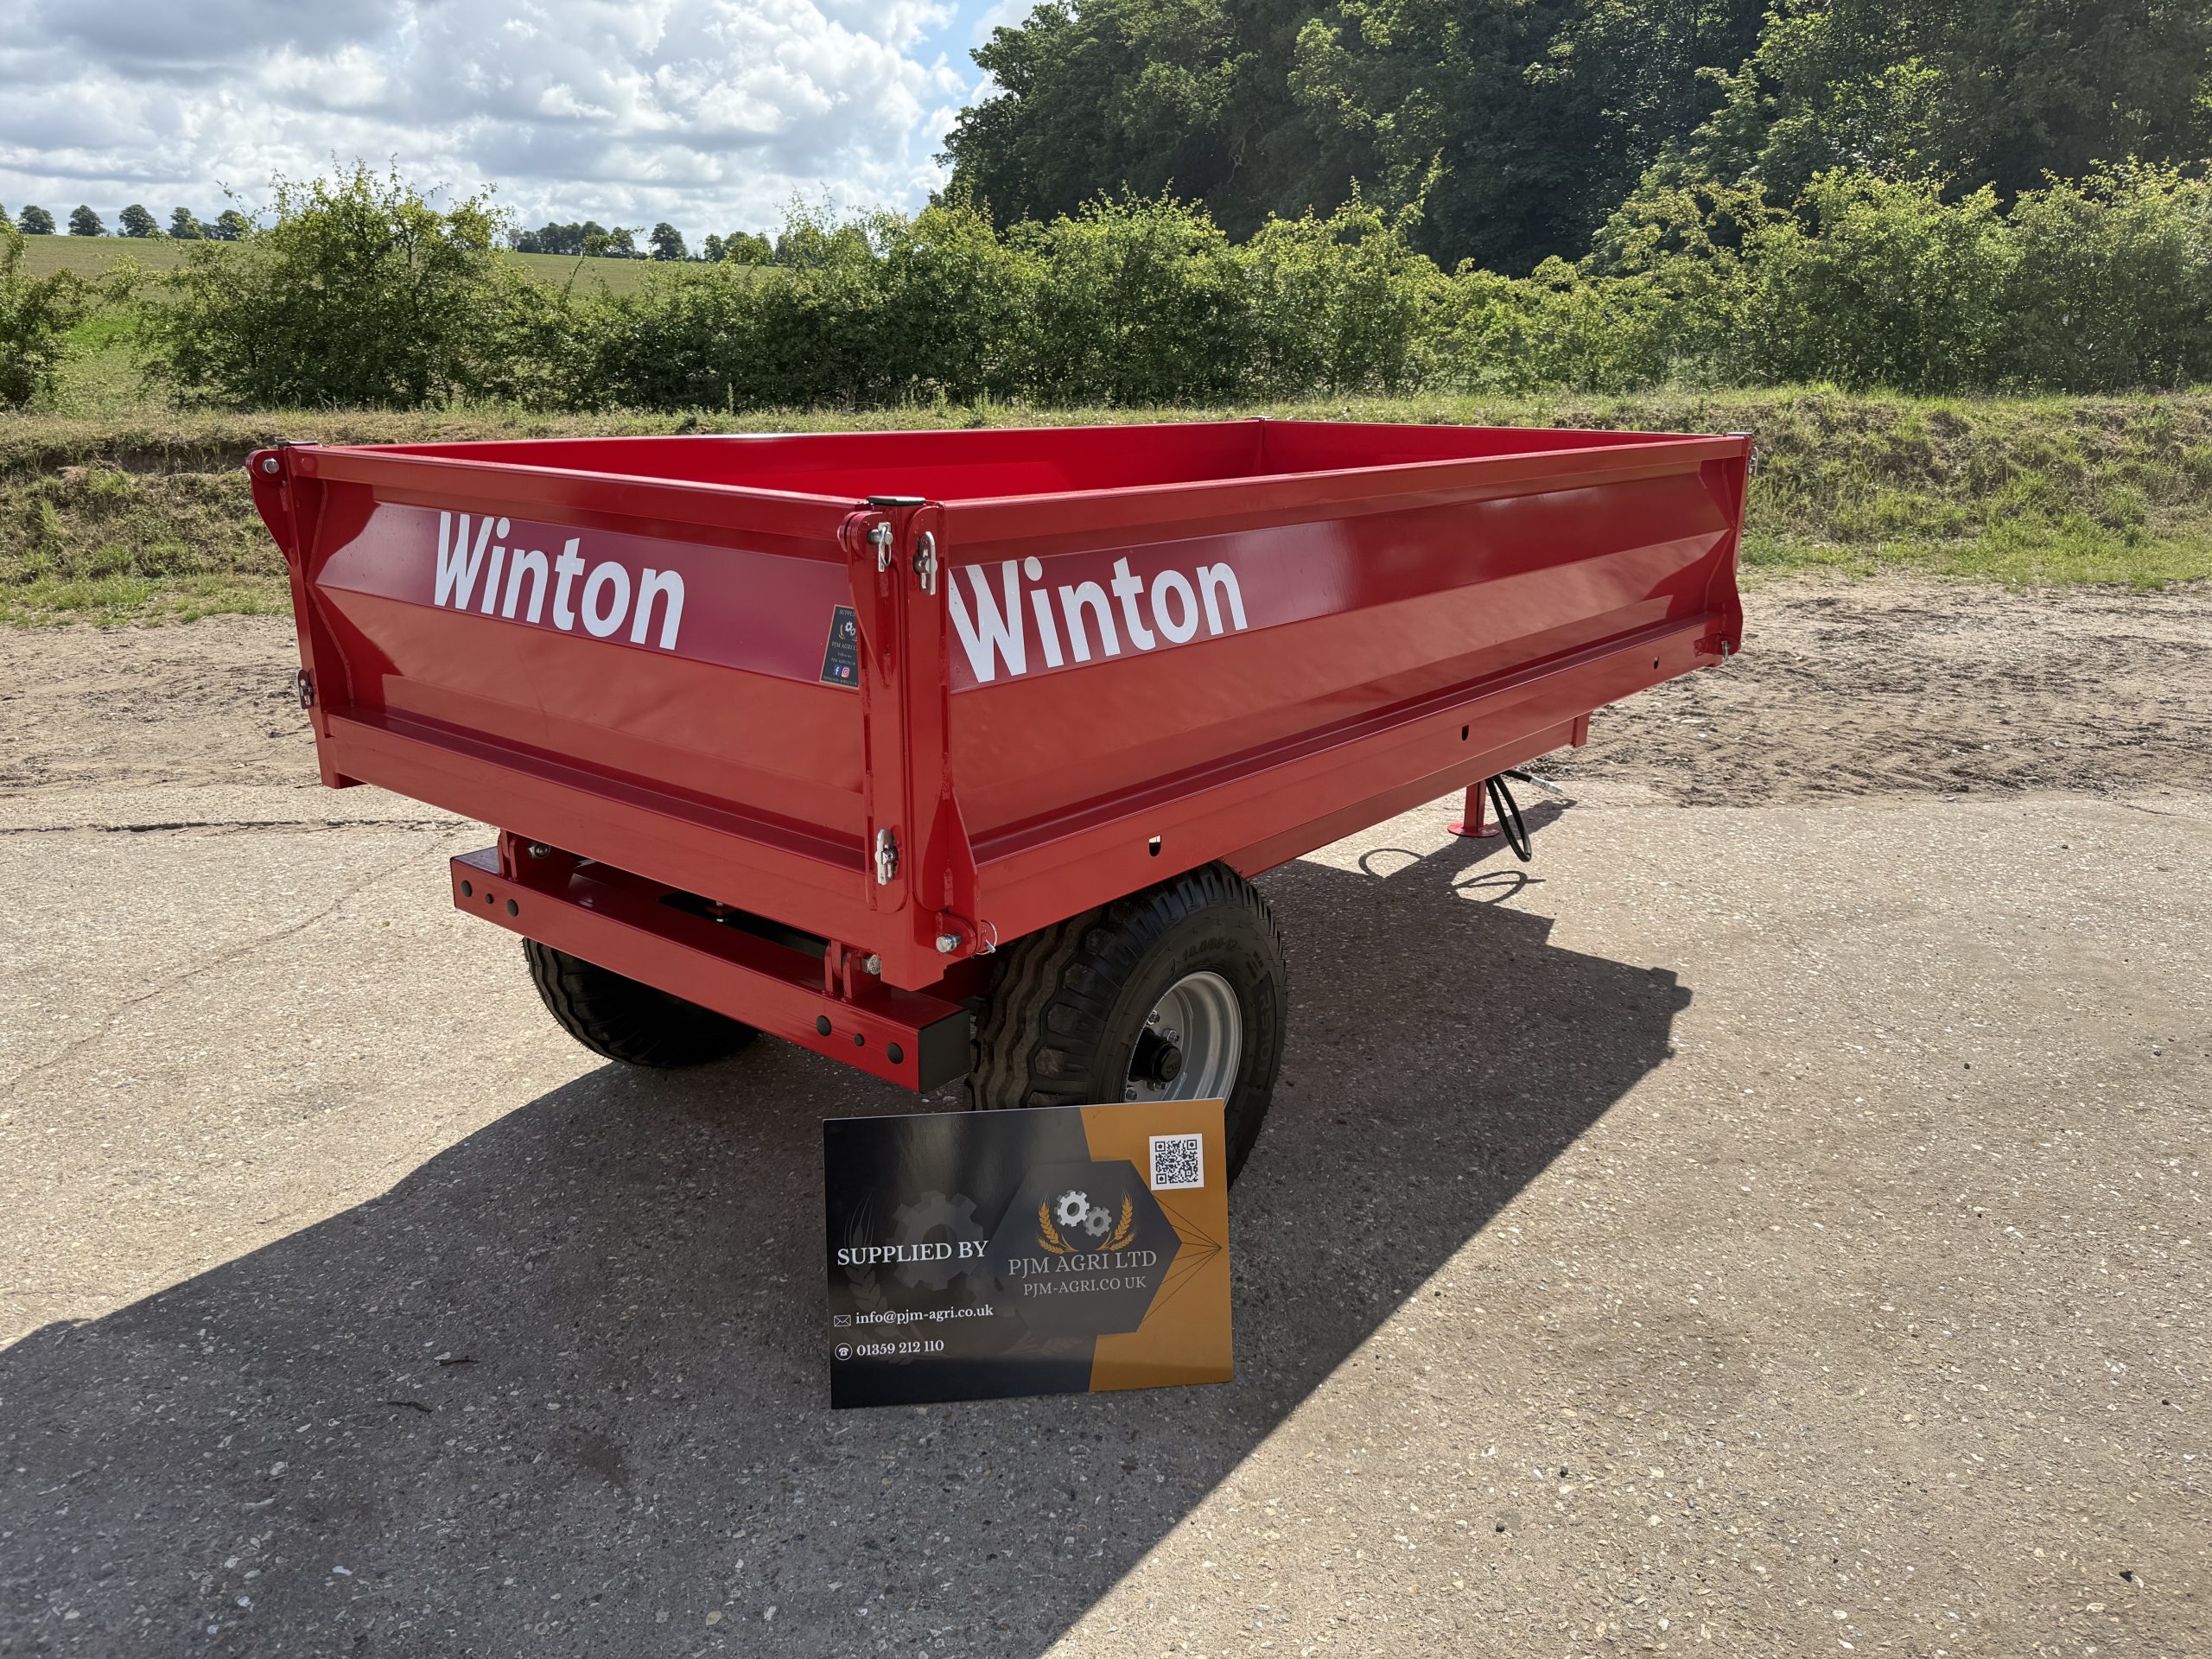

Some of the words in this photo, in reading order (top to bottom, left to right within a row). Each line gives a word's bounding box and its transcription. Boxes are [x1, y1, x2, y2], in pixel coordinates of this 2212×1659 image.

[434, 511, 685, 651] Winton
[949, 556, 1249, 683] Winton
[837, 1243, 952, 1266] SUPPLIED
[958, 1240, 989, 1259] BY
[1008, 1256, 1050, 1279] PJM
[1055, 1253, 1109, 1274] AGRI
[1116, 1250, 1157, 1268] LTD
[855, 1304, 995, 1325] info@pjm-agri.co.uk
[856, 1343, 896, 1357] 01359
[899, 1341, 921, 1354] 212
[924, 1339, 944, 1352] 110
